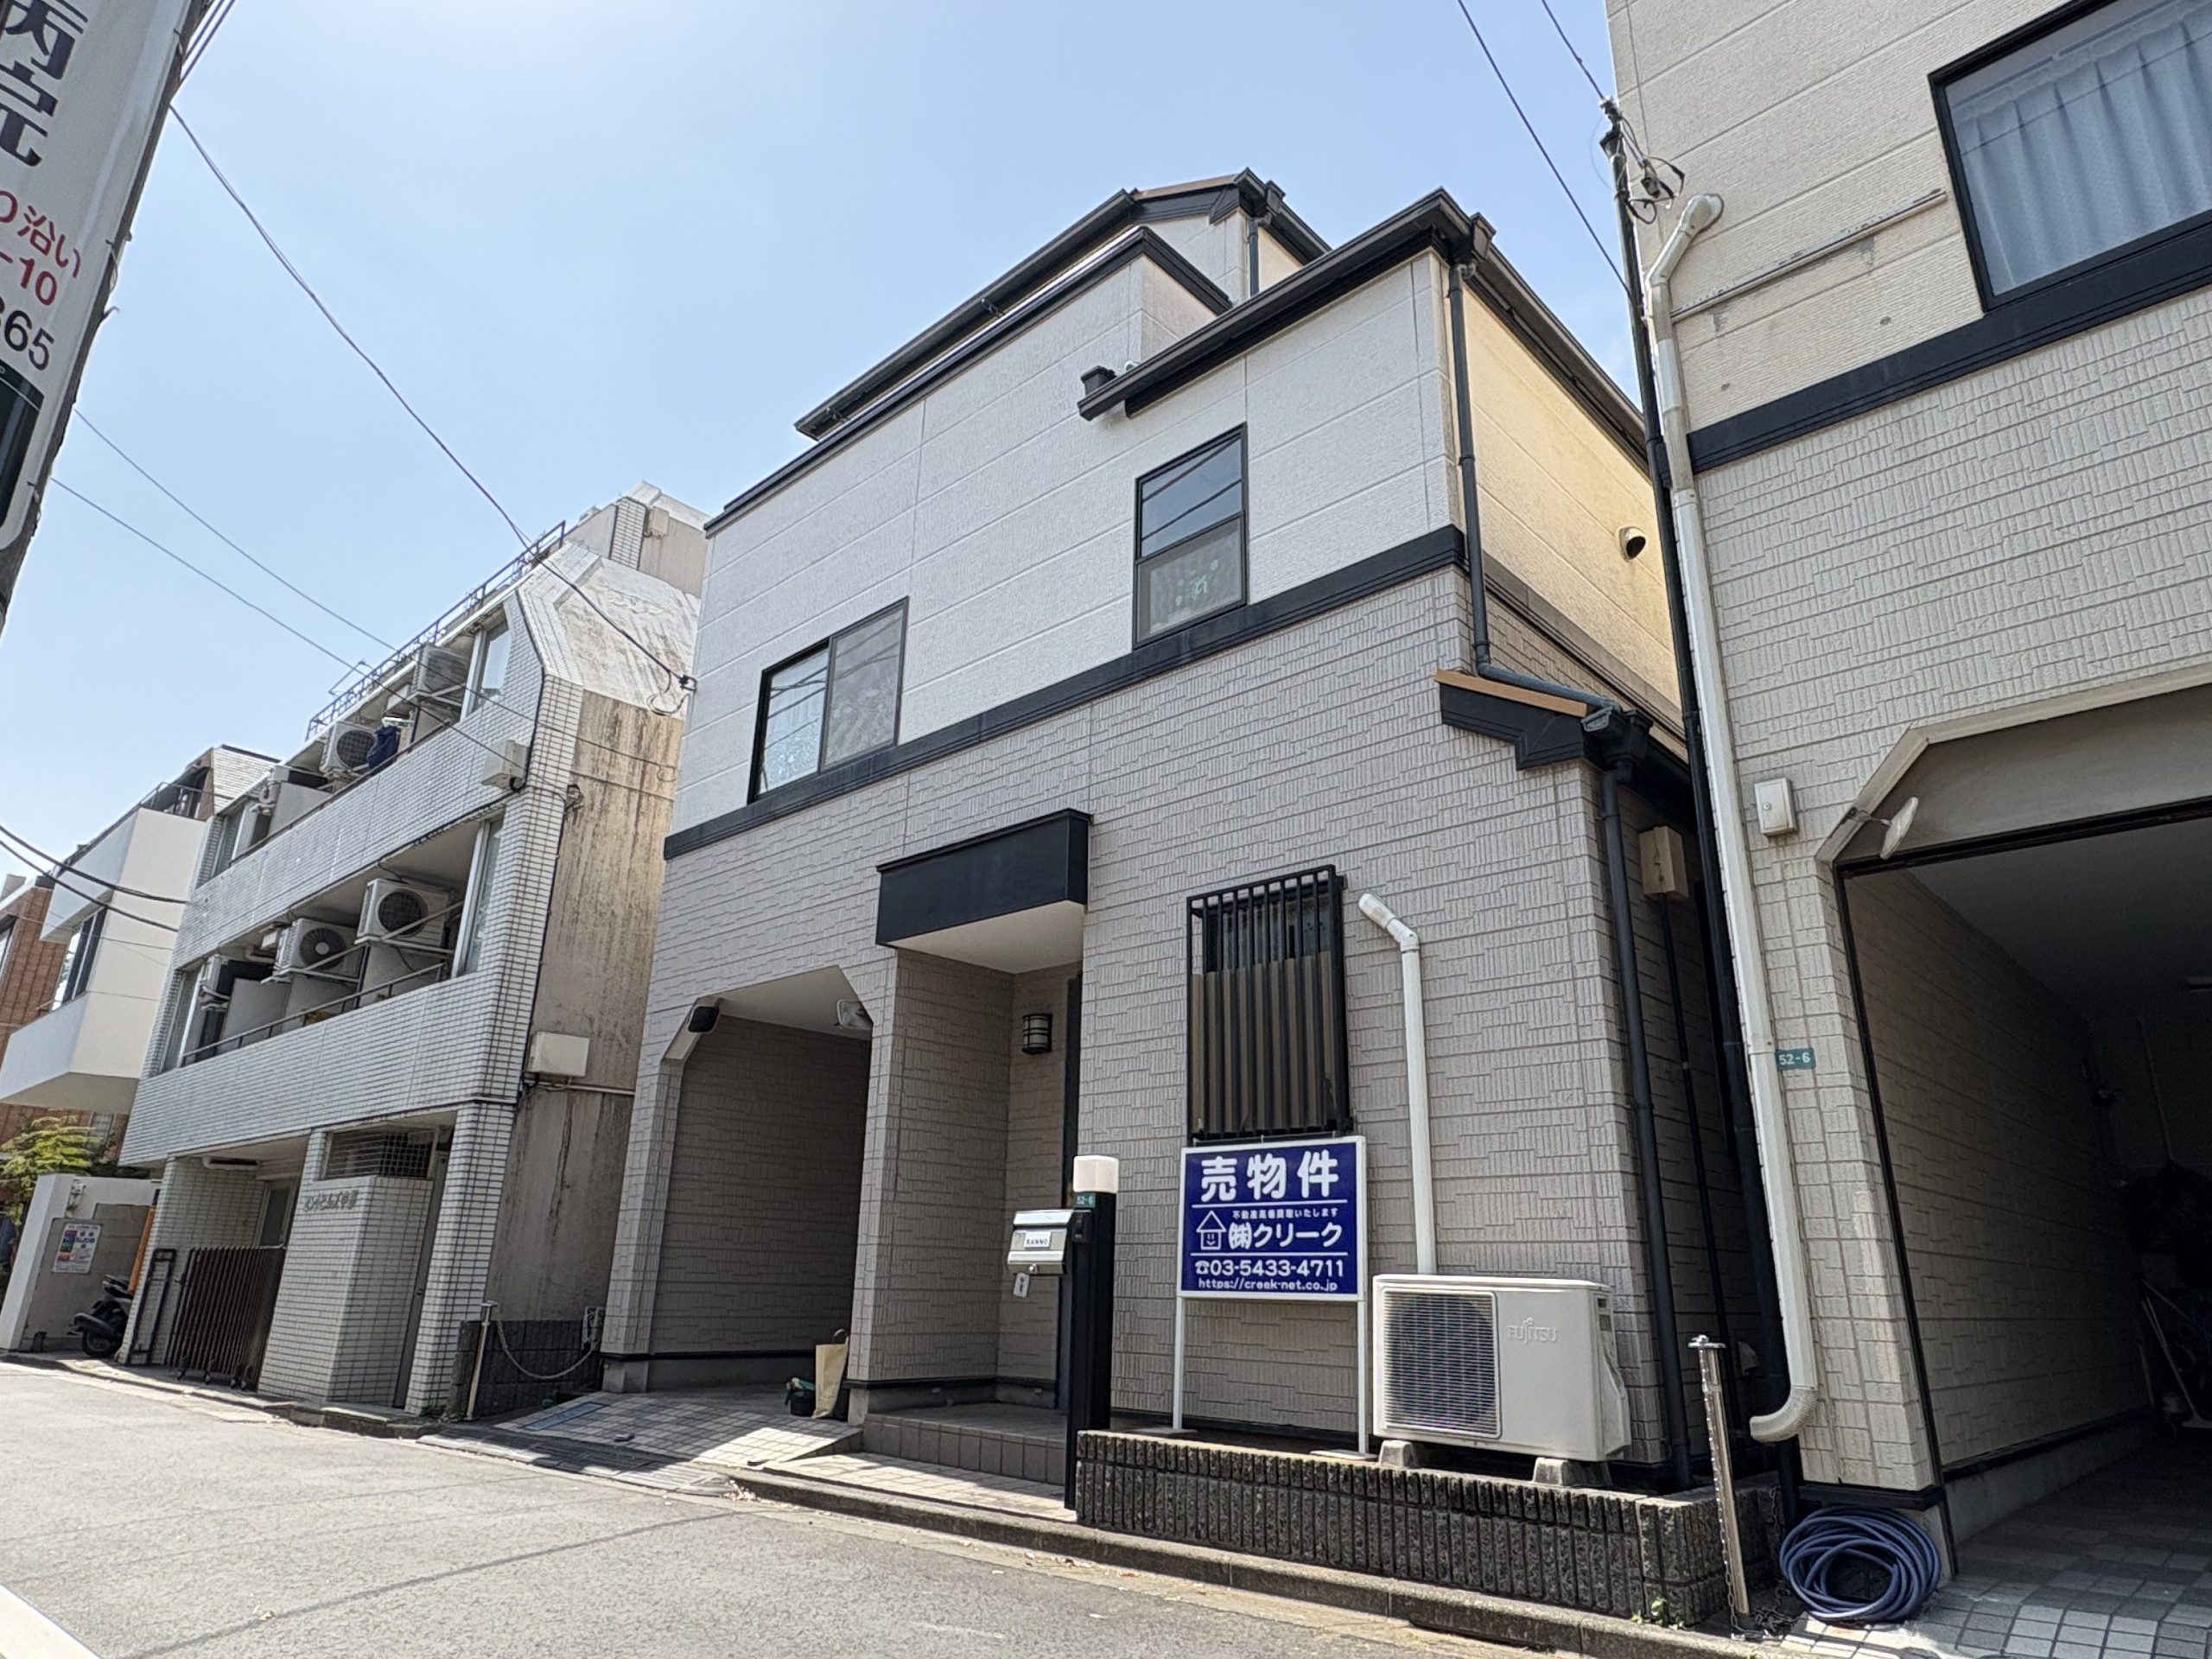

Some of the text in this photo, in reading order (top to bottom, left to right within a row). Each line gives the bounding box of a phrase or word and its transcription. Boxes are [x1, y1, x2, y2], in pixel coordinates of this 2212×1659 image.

[1779, 1052, 1811, 1065] 52-6
[1201, 1149, 1339, 1202] 売物件
[1077, 1195, 1093, 1205] 52-6
[1210, 1259, 1344, 1277] 03-5433-4711
[1198, 1277, 1338, 1292] https://creek-net.co.jp
[1507, 1317, 1557, 1345] FUJITSU
